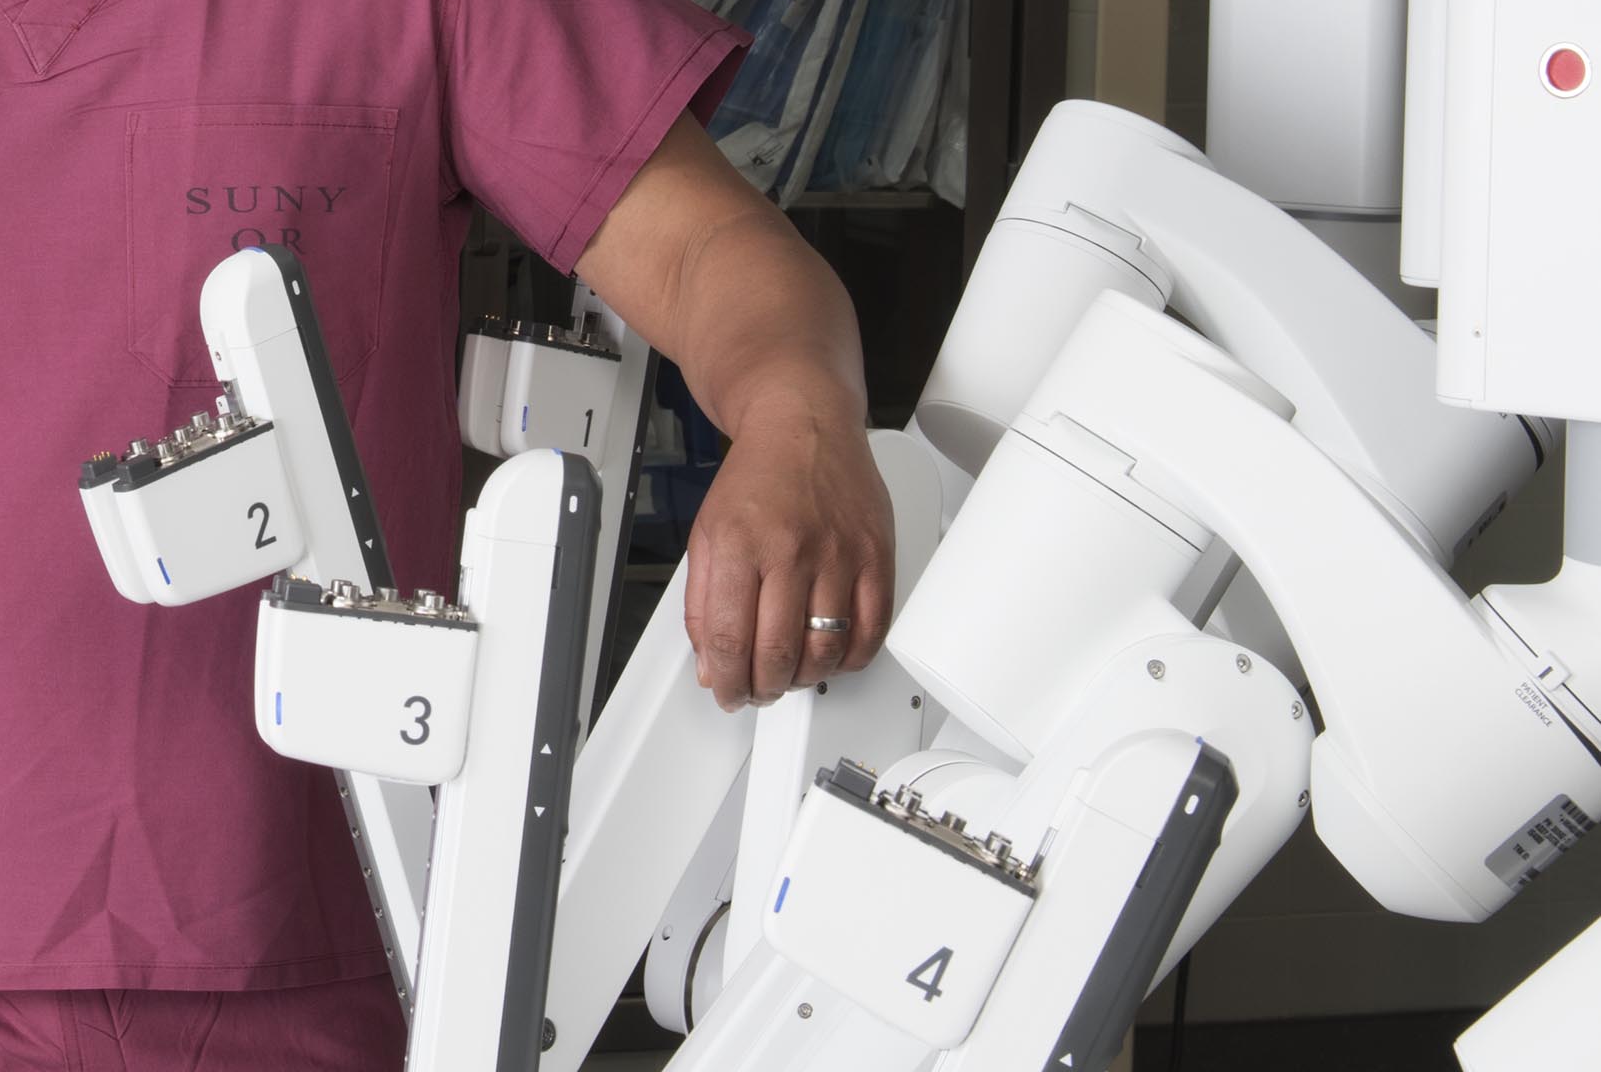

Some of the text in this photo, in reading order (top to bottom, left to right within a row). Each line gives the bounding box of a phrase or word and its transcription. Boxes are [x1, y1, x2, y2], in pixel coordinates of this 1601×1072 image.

[185, 185, 348, 215] SUNY
[231, 228, 307, 255] OR
[584, 409, 593, 448] 1
[246, 501, 278, 550] 2
[1514, 688, 1554, 728] CLEARANCE
[1520, 681, 1549, 710] PATIENT
[399, 695, 433, 746] 3
[905, 946, 955, 1003] 4
